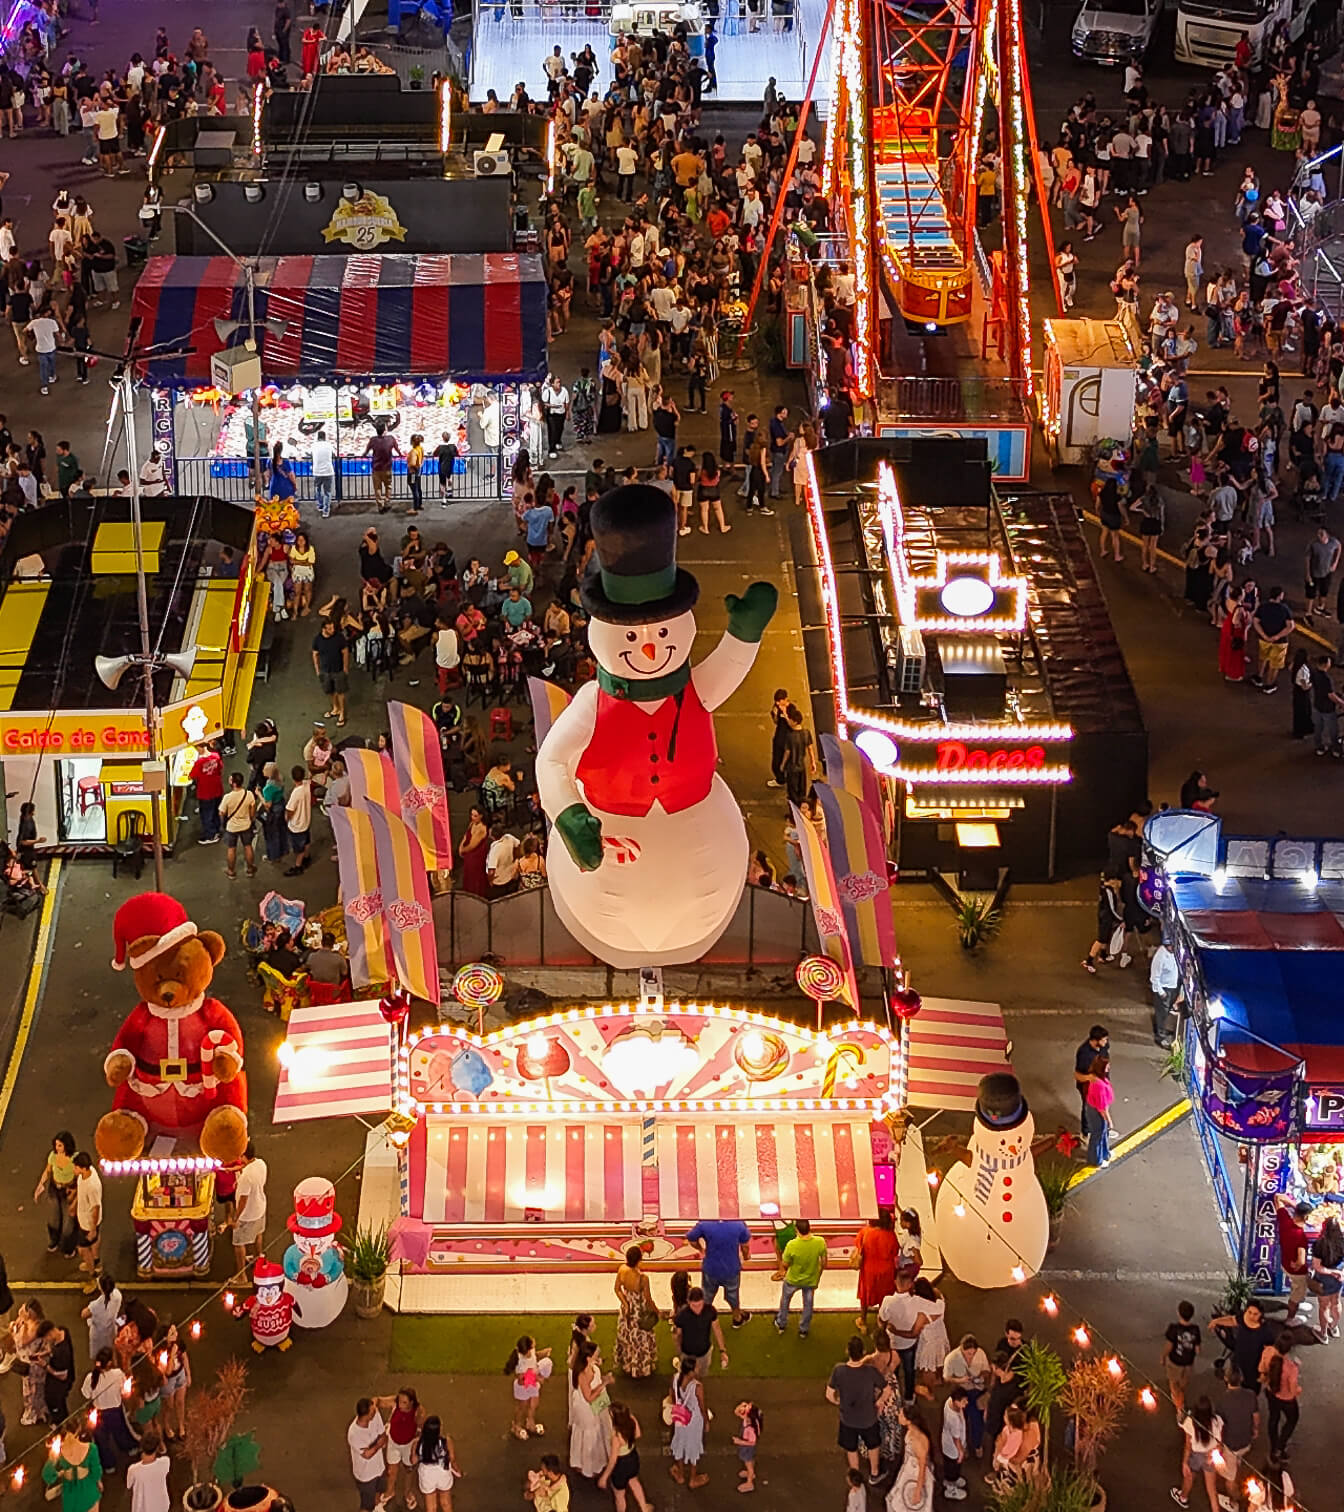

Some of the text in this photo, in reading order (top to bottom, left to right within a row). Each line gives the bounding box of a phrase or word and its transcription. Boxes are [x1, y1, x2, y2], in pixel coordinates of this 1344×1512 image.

[356, 227, 376, 244] 25
[71, 727, 96, 748] de
[937, 740, 1046, 769] Doces
